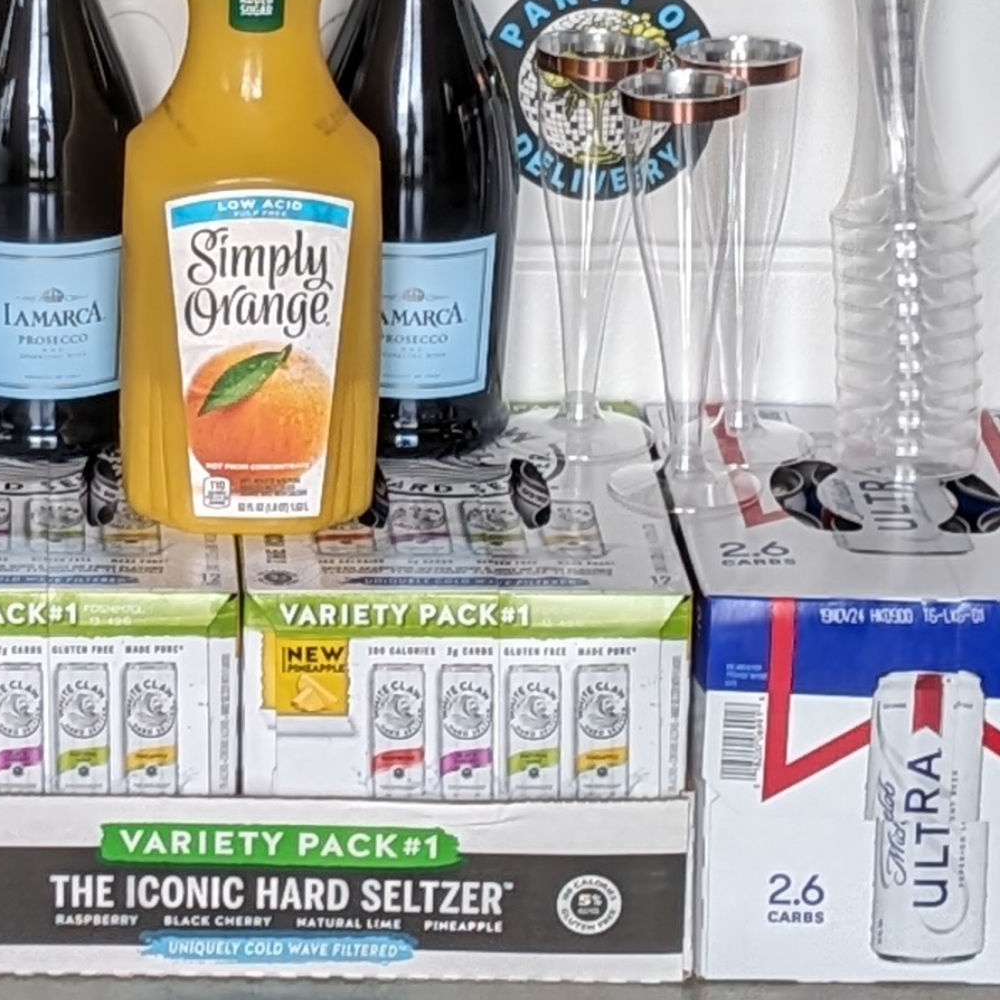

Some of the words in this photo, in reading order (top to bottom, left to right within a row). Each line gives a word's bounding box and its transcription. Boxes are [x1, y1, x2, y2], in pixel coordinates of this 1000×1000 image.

[217, 199, 255, 211] LOW
[262, 199, 302, 210] ACID
[187, 227, 333, 291] Simply
[184, 285, 327, 338] Orange
[18, 334, 88, 345] PROSECCO
[720, 541, 790, 558] 2.6
[280, 603, 408, 626] VARIETY
[12, 646, 42, 654] CARBS
[51, 646, 87, 654] GLUTEN
[92, 646, 114, 654] FREE
[125, 645, 150, 654] MADE
[288, 647, 344, 662] NEW
[368, 647, 385, 656] 100
[389, 647, 435, 656] CALORIES
[463, 647, 493, 656] CARBS
[504, 647, 540, 656] GLUTEN
[543, 647, 566, 656] FREE
[578, 647, 603, 656] MADE
[904, 747, 950, 908] ULTRA
[119, 829, 285, 857] VARIETY
[49, 873, 115, 909] THE
[126, 874, 244, 911] ICONIC
[256, 877, 350, 913] HARD
[768, 873, 825, 906] 2.6
[55, 913, 138, 927] RASPBERRY
[164, 915, 210, 927] BLACK
[214, 916, 273, 928] CHERRY
[296, 917, 362, 929] NATURAL
[366, 918, 401, 930] LIME
[424, 919, 503, 932] PINEAPPLE
[767, 911, 824, 924] CARBS
[168, 940, 241, 957] UNIQUELY
[244, 942, 284, 956] COLD
[289, 942, 329, 957] WAVE
[333, 943, 399, 958] FILTERED
